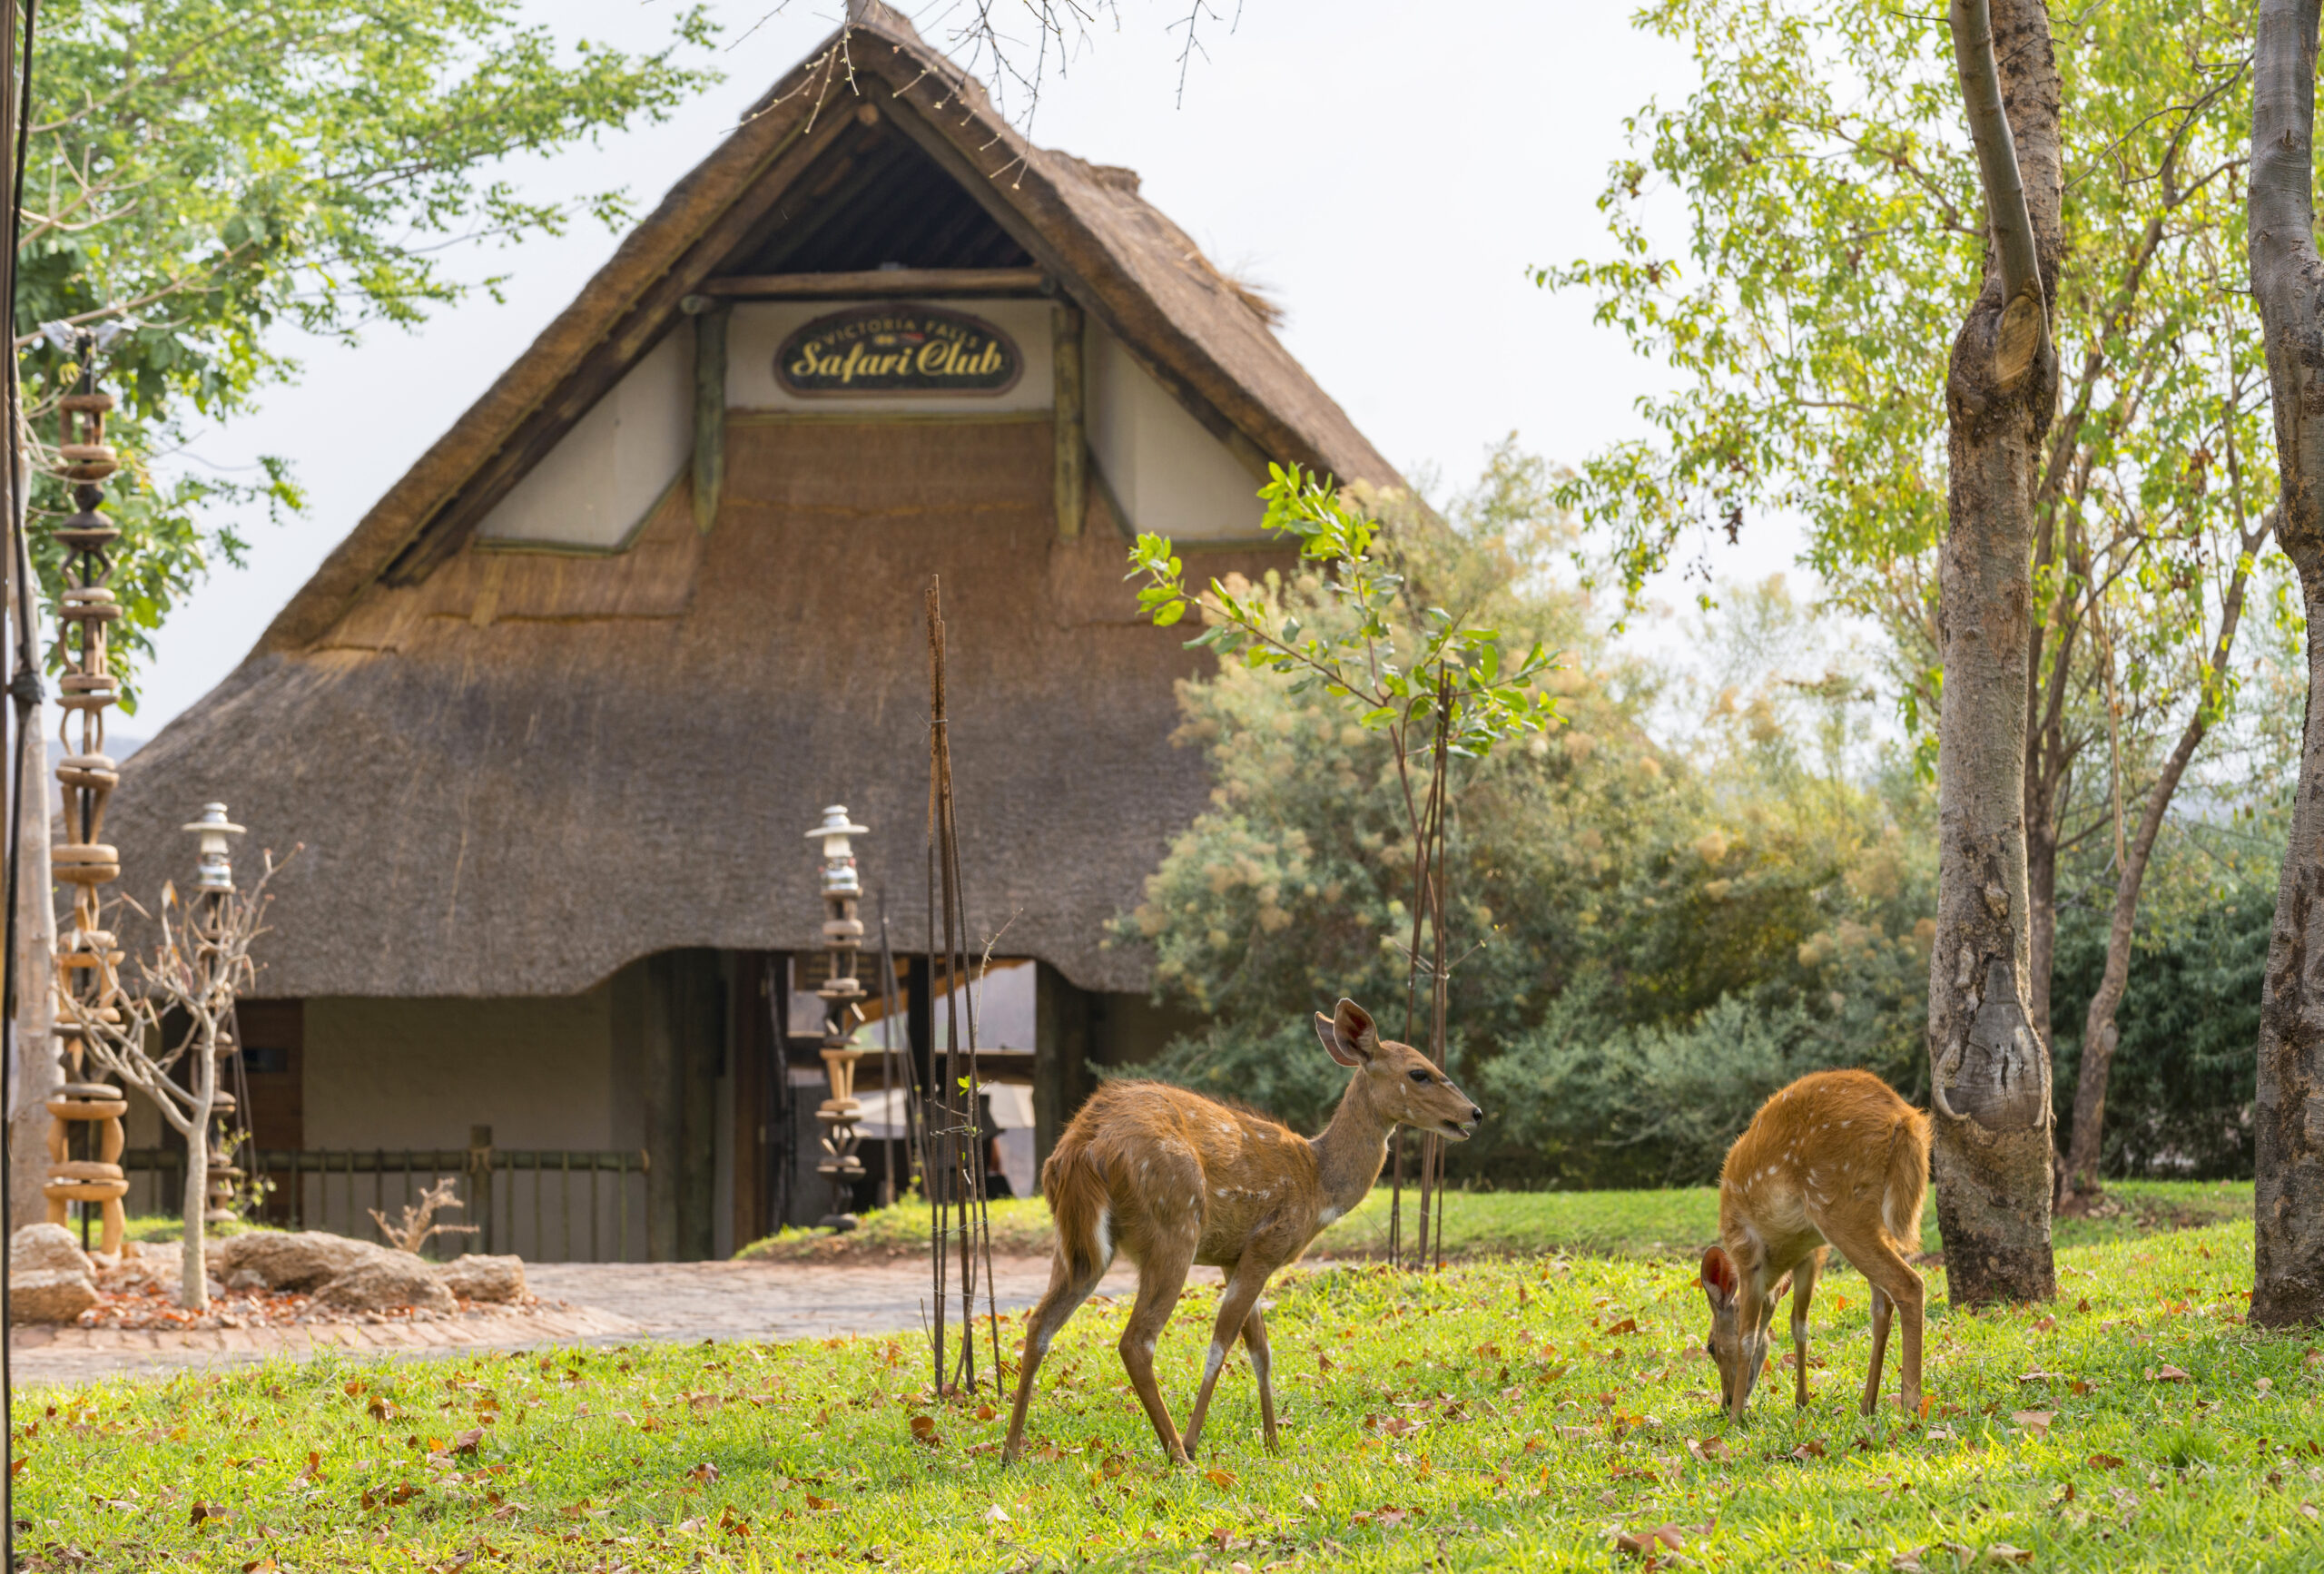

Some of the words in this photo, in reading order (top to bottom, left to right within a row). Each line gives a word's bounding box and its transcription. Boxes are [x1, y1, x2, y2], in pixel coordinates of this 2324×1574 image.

[823, 319, 916, 345] VICTORIA
[924, 320, 980, 348] FALLS
[791, 341, 913, 383] Safari
[916, 339, 1002, 376] Club
